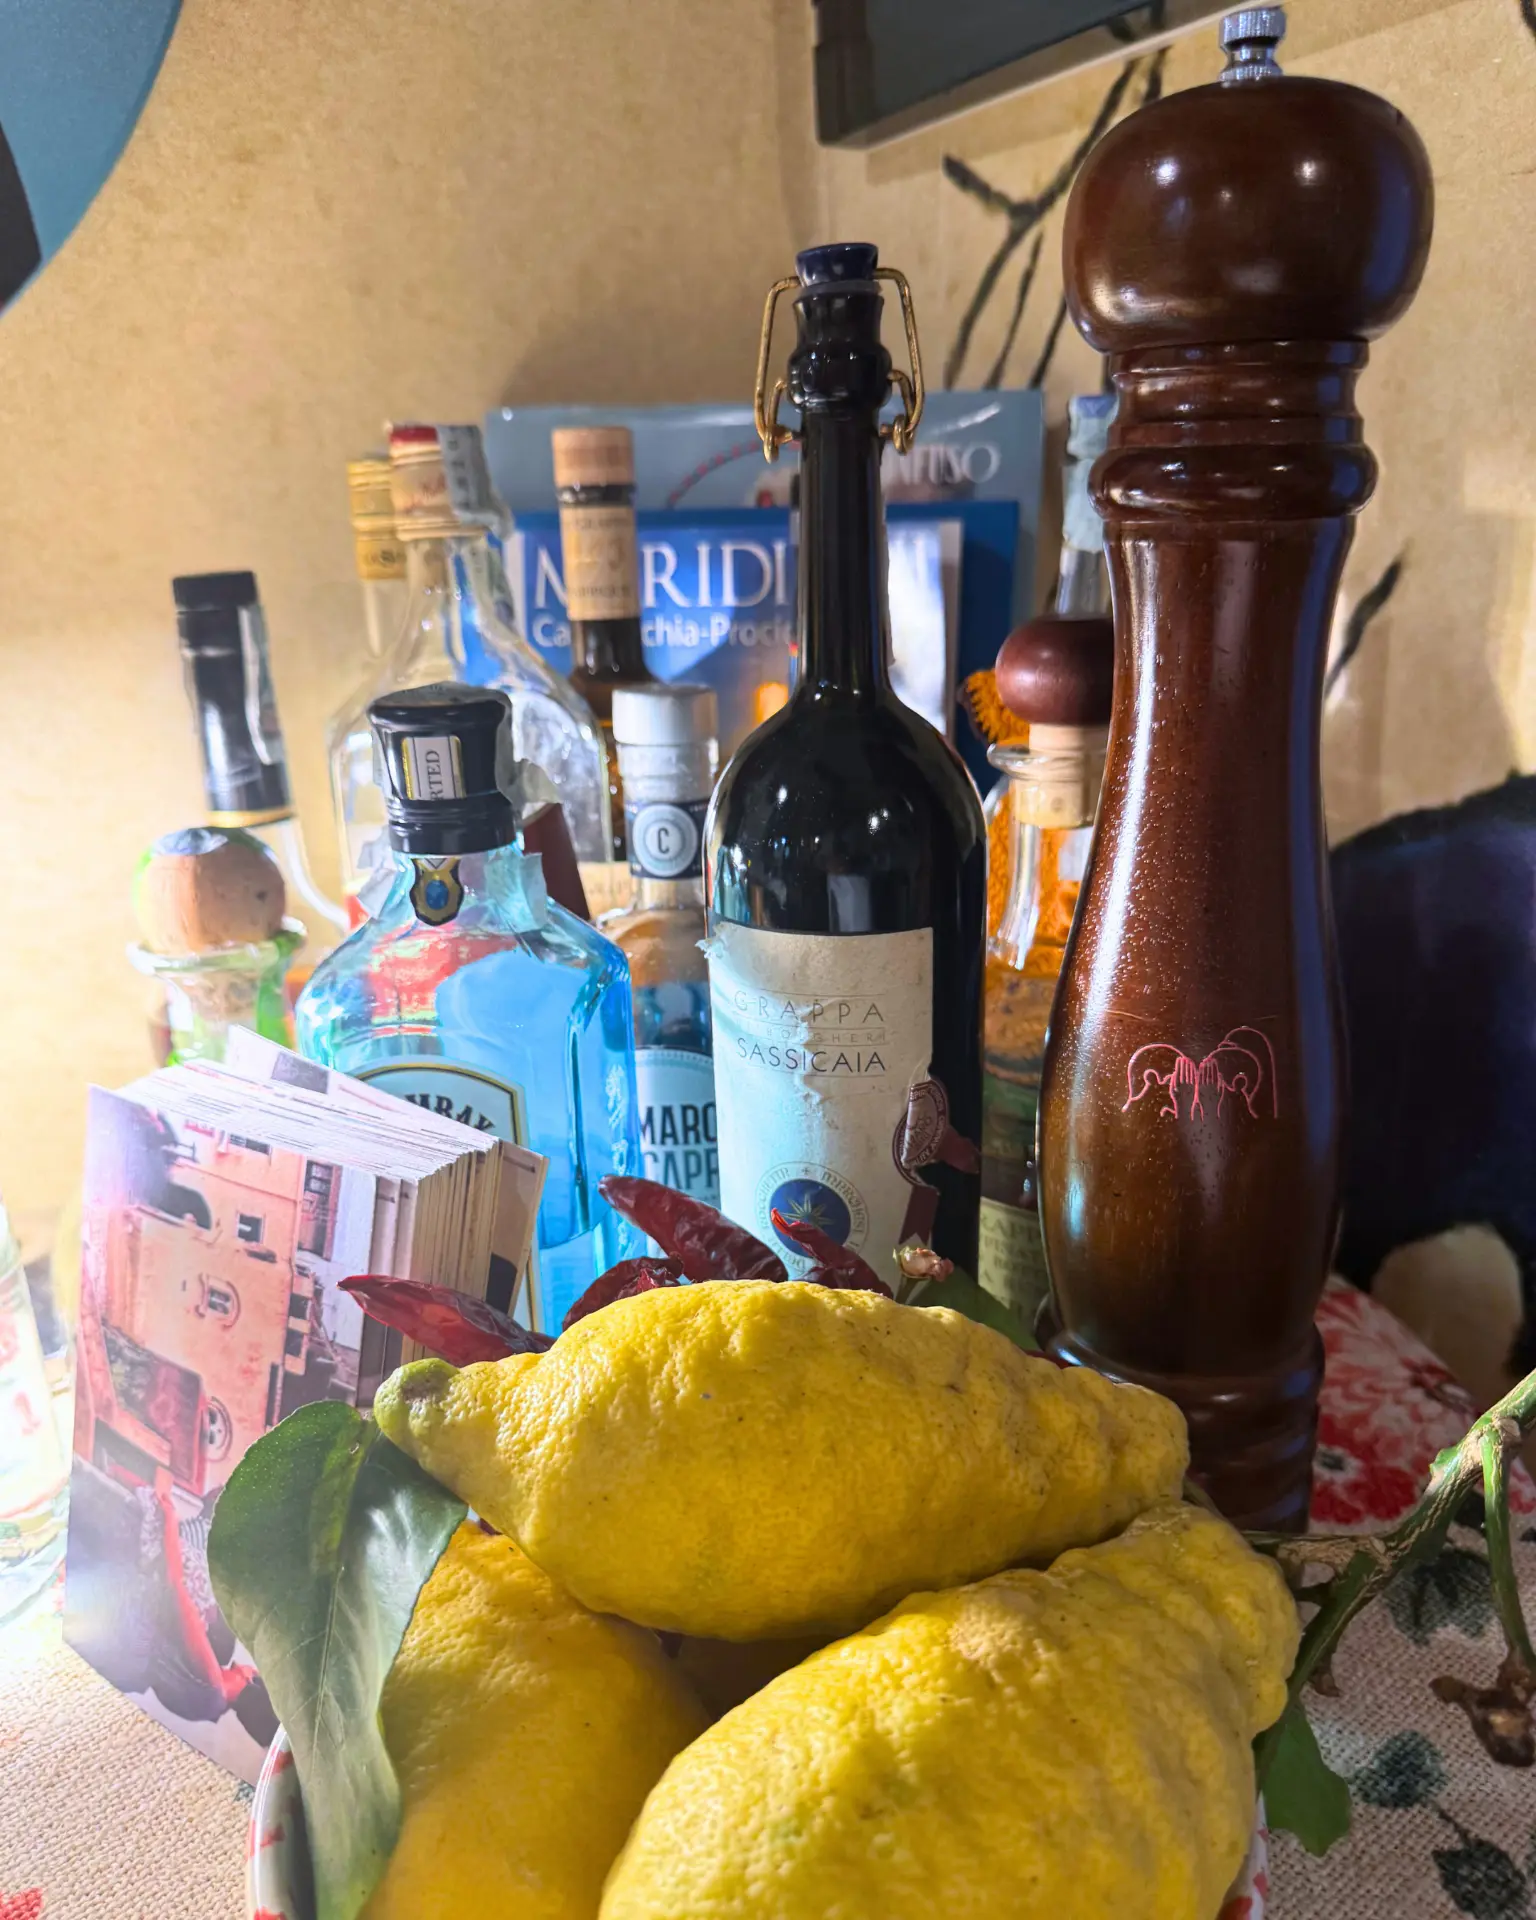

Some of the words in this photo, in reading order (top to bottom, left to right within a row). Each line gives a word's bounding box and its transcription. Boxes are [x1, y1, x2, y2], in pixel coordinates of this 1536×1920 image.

[657, 827, 671, 855] C
[734, 990, 884, 1024] GRAPPA
[766, 1028, 886, 1044] OGHERI
[736, 1037, 887, 1074] SASSICAIA
